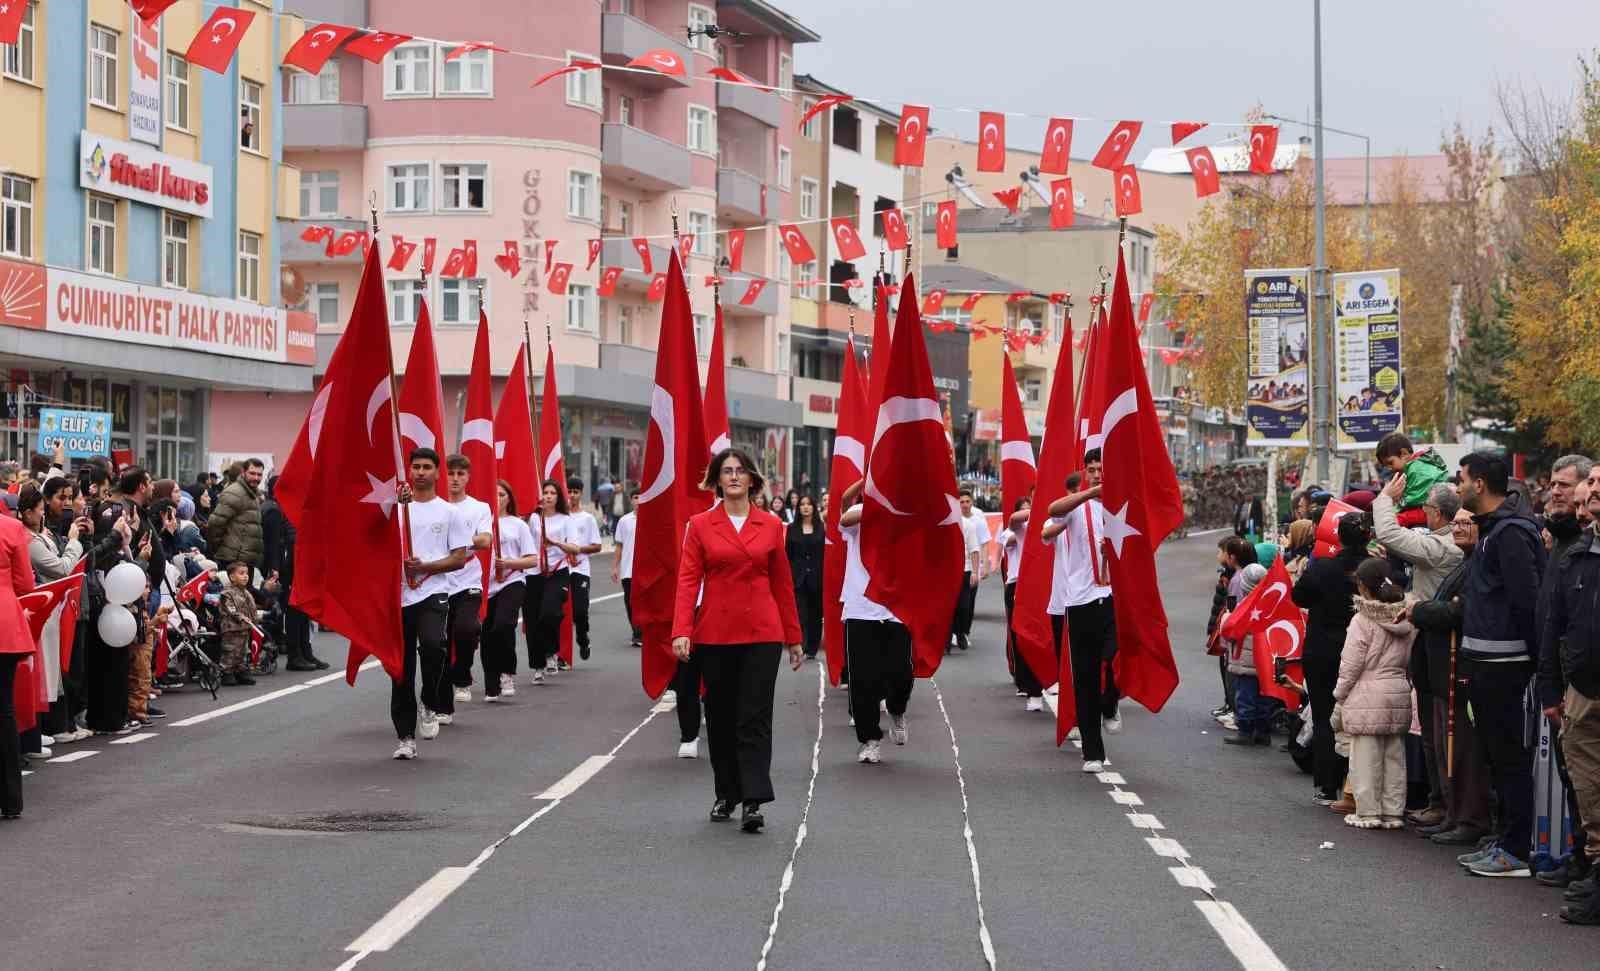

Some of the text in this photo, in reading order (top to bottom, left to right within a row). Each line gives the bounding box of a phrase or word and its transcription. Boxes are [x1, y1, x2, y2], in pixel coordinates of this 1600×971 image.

[109, 152, 209, 205] final kurs
[56, 282, 278, 353] CUMHURİYET HALK PARTİSİ
[61, 413, 89, 433] ELİF
[69, 436, 105, 453] OCAĞI
